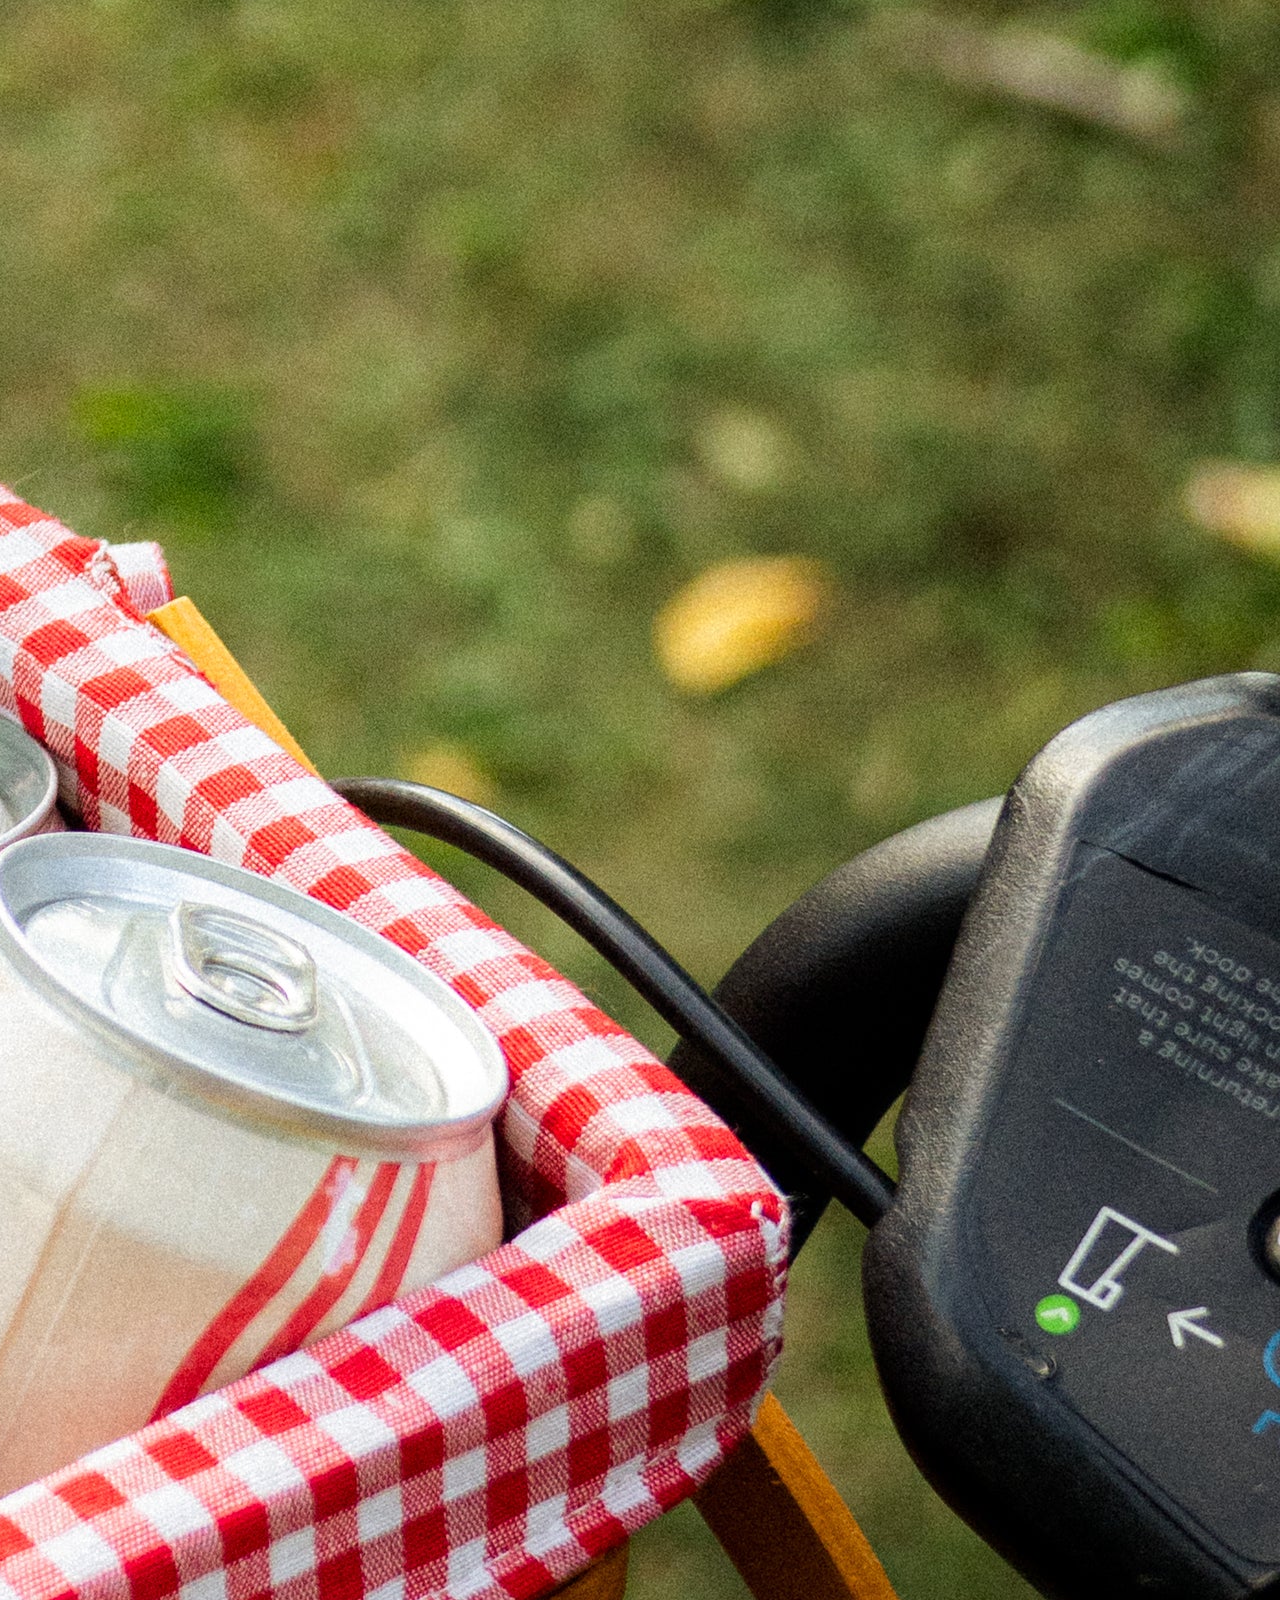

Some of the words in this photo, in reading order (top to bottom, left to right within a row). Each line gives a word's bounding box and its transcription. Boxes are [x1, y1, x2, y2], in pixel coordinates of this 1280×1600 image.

[1153, 951, 1196, 984] the
[1185, 935, 1252, 982] dock.
[1113, 957, 1195, 1010] comes
[1199, 974, 1280, 1031] ocking
[1255, 977, 1280, 1004] he
[1112, 986, 1169, 1028] that
[1200, 1005, 1260, 1050] light
[1139, 1029, 1154, 1046] a
[1173, 1021, 1233, 1061] sure
[1236, 1057, 1280, 1090] ake
